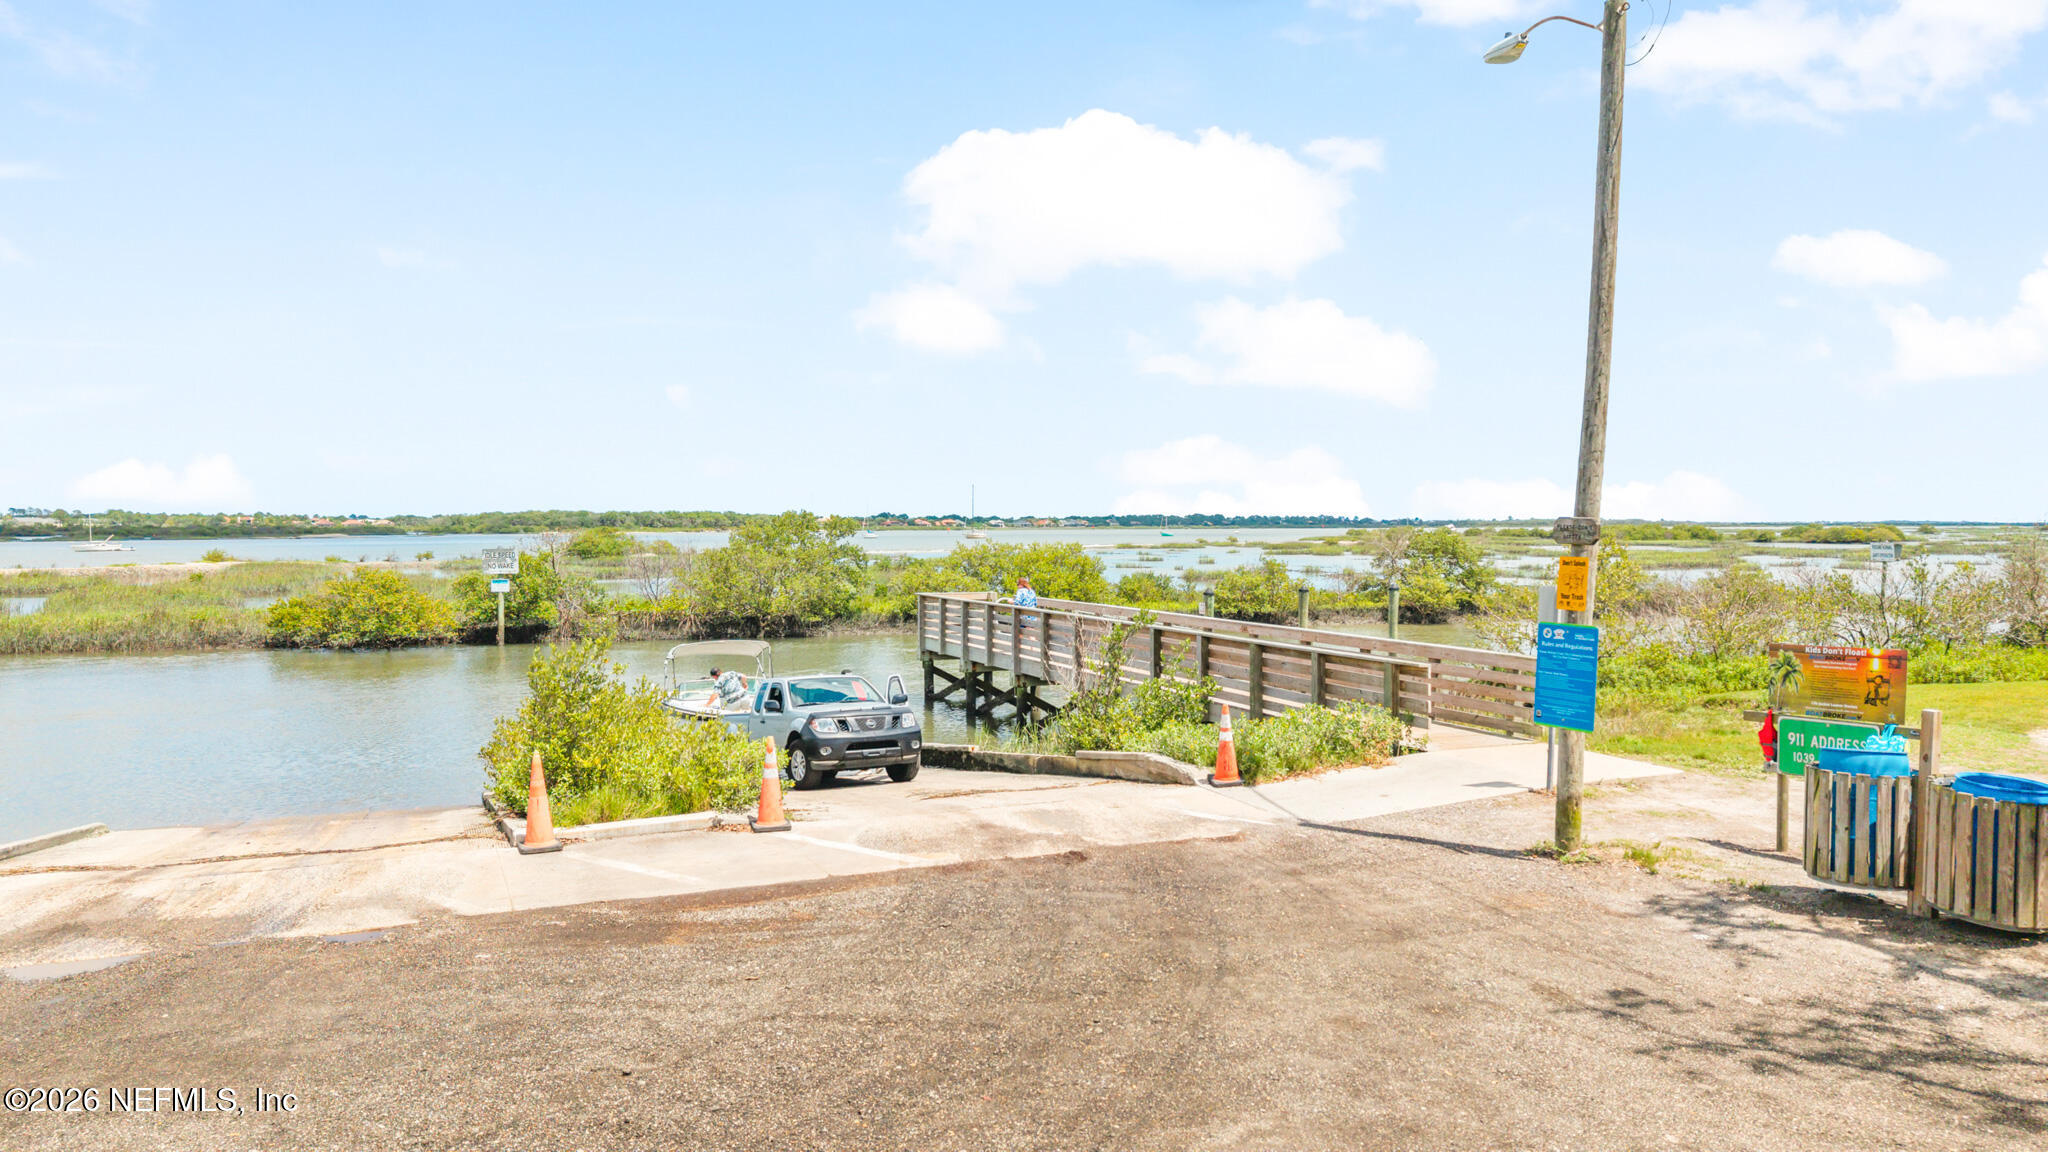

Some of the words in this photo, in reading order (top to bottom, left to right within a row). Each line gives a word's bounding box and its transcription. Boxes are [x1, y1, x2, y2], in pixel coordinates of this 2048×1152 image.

[1565, 643, 1594, 652] Regulations
[1805, 646, 1822, 654] Kids
[1822, 647, 1844, 656] Don't
[1844, 648, 1868, 657] Float!
[1788, 732, 1804, 747] 911
[1811, 735, 1867, 750] ADDRESS
[1793, 751, 1815, 763] 1039
